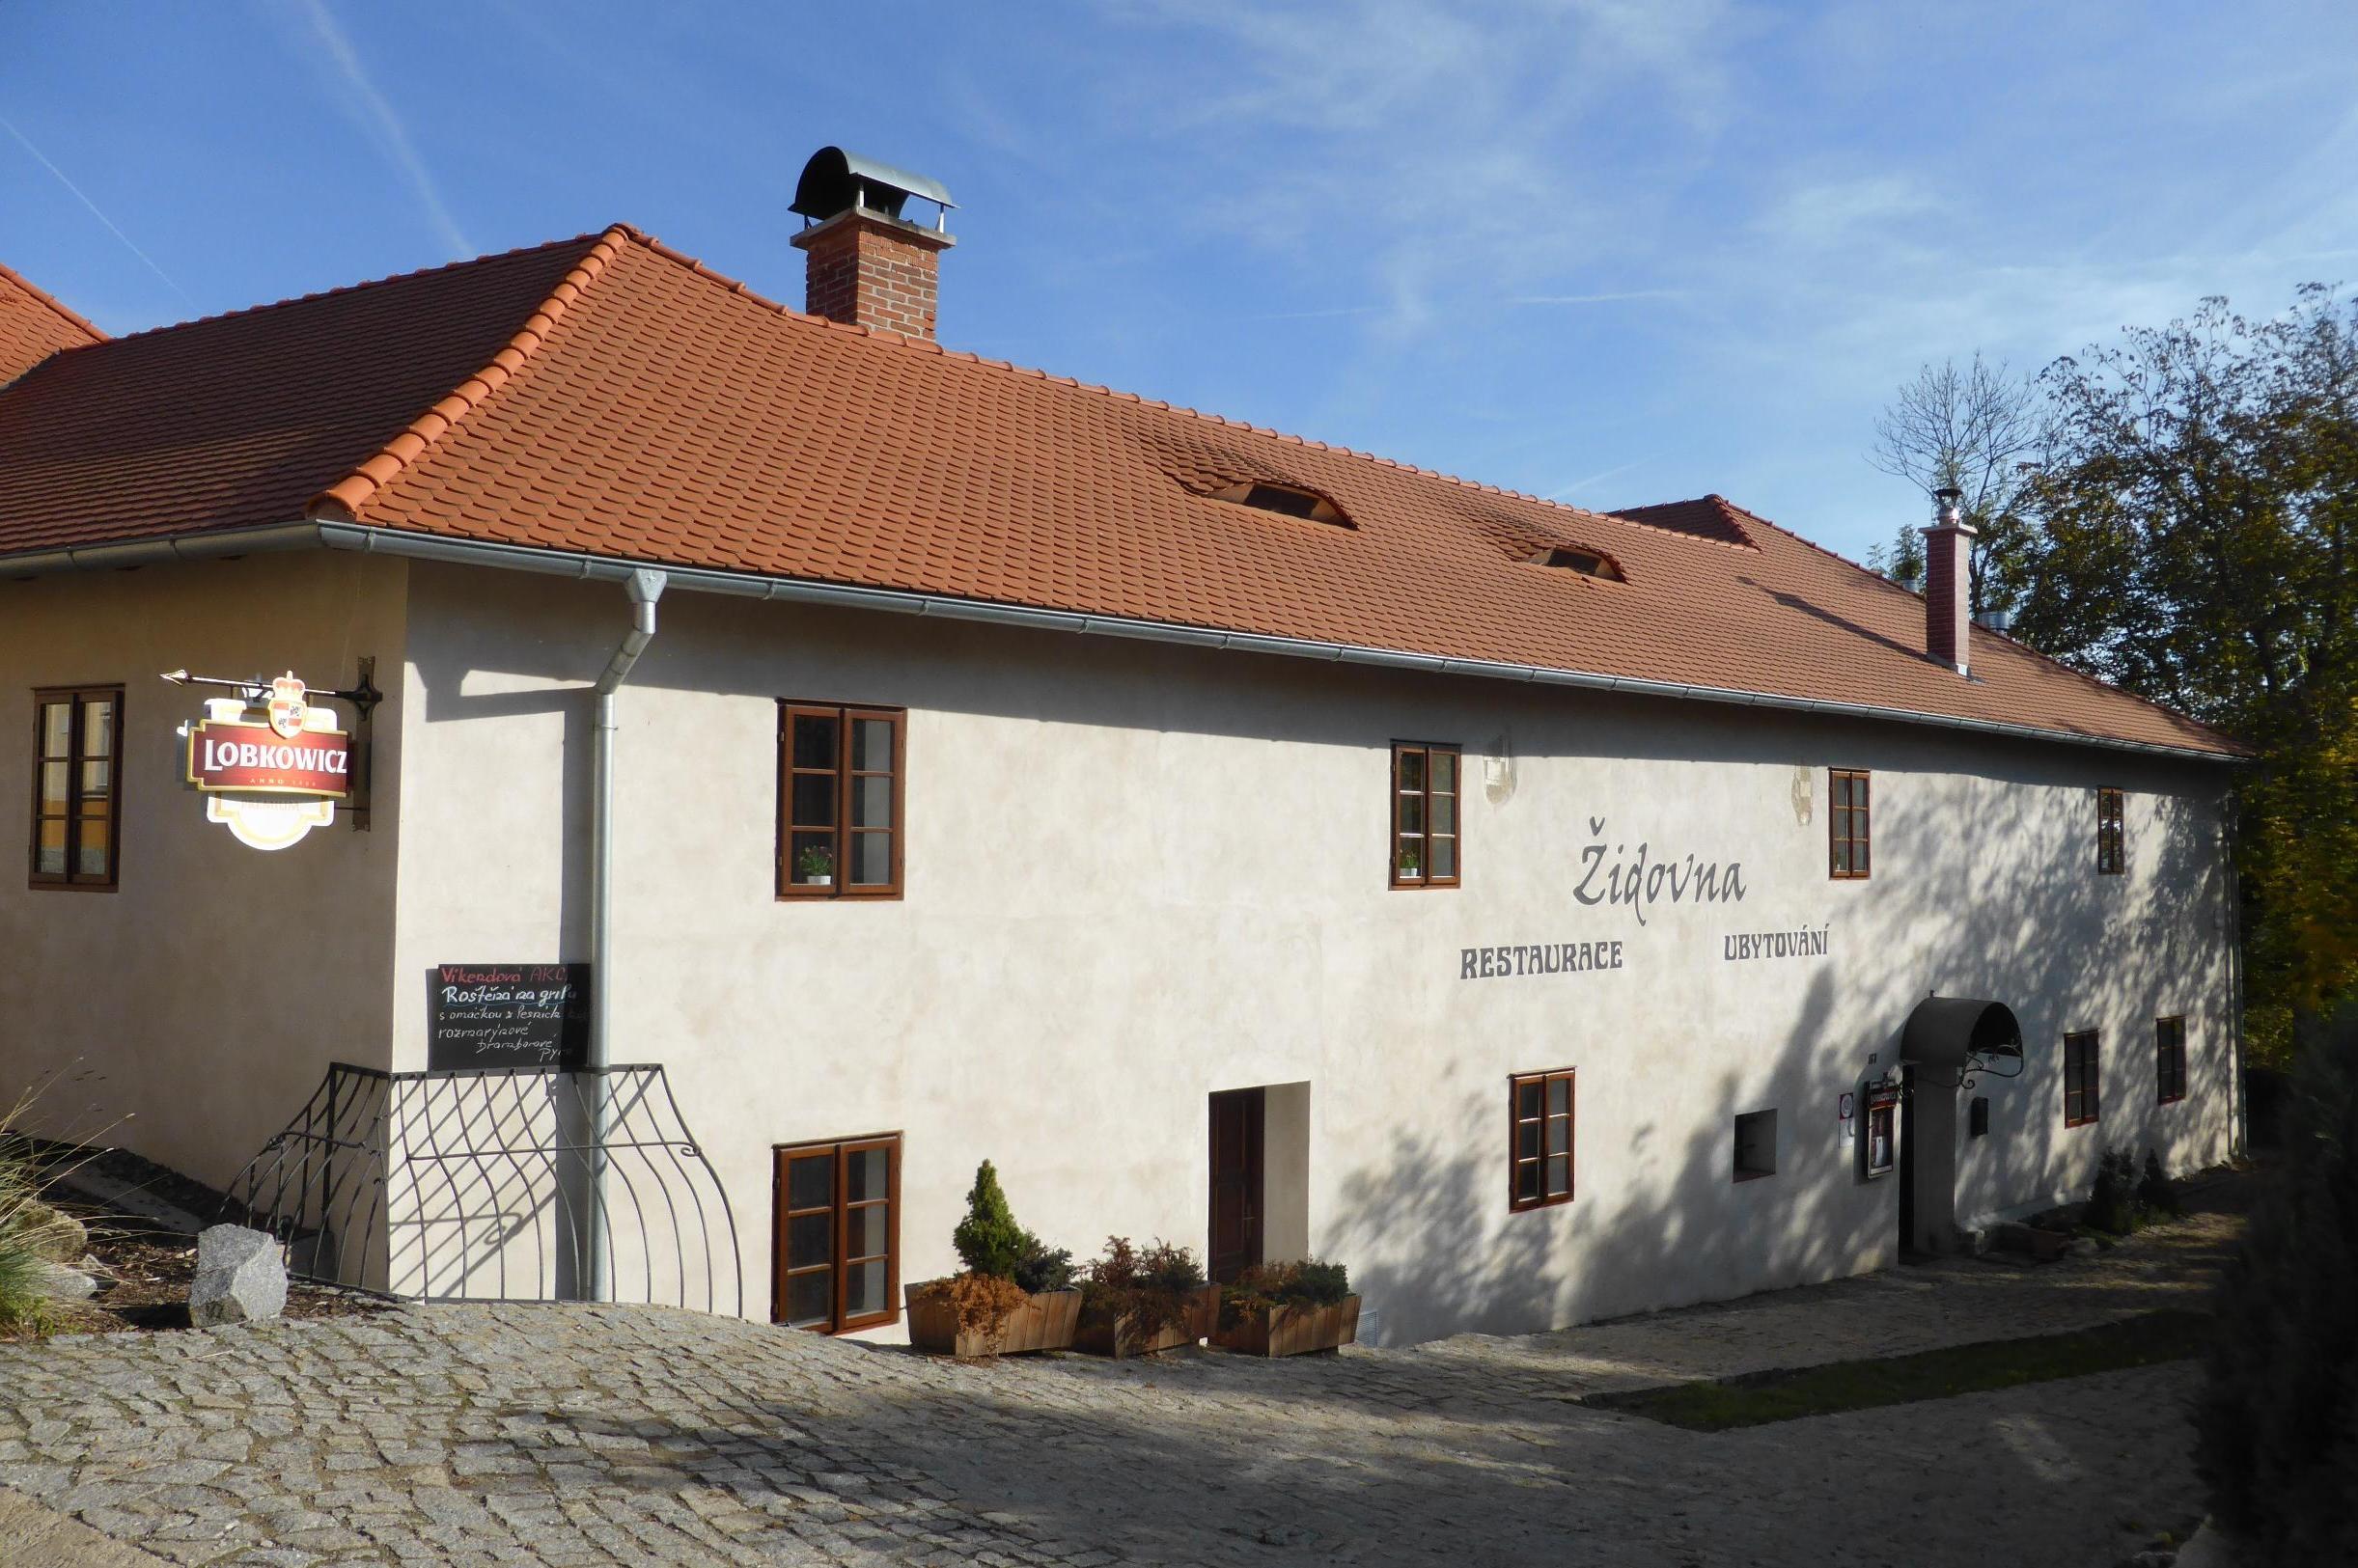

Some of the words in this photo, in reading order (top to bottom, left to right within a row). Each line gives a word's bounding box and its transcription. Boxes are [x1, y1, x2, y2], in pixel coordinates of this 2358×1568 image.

[204, 739, 347, 774] LOBKOWICZ
[1572, 816, 1747, 926] Židovna
[1459, 941, 1623, 979] RESTAURACE
[1724, 923, 1830, 961] UBYTOVÁNÍ
[515, 990, 535, 1001] na
[439, 1011, 446, 1021] s
